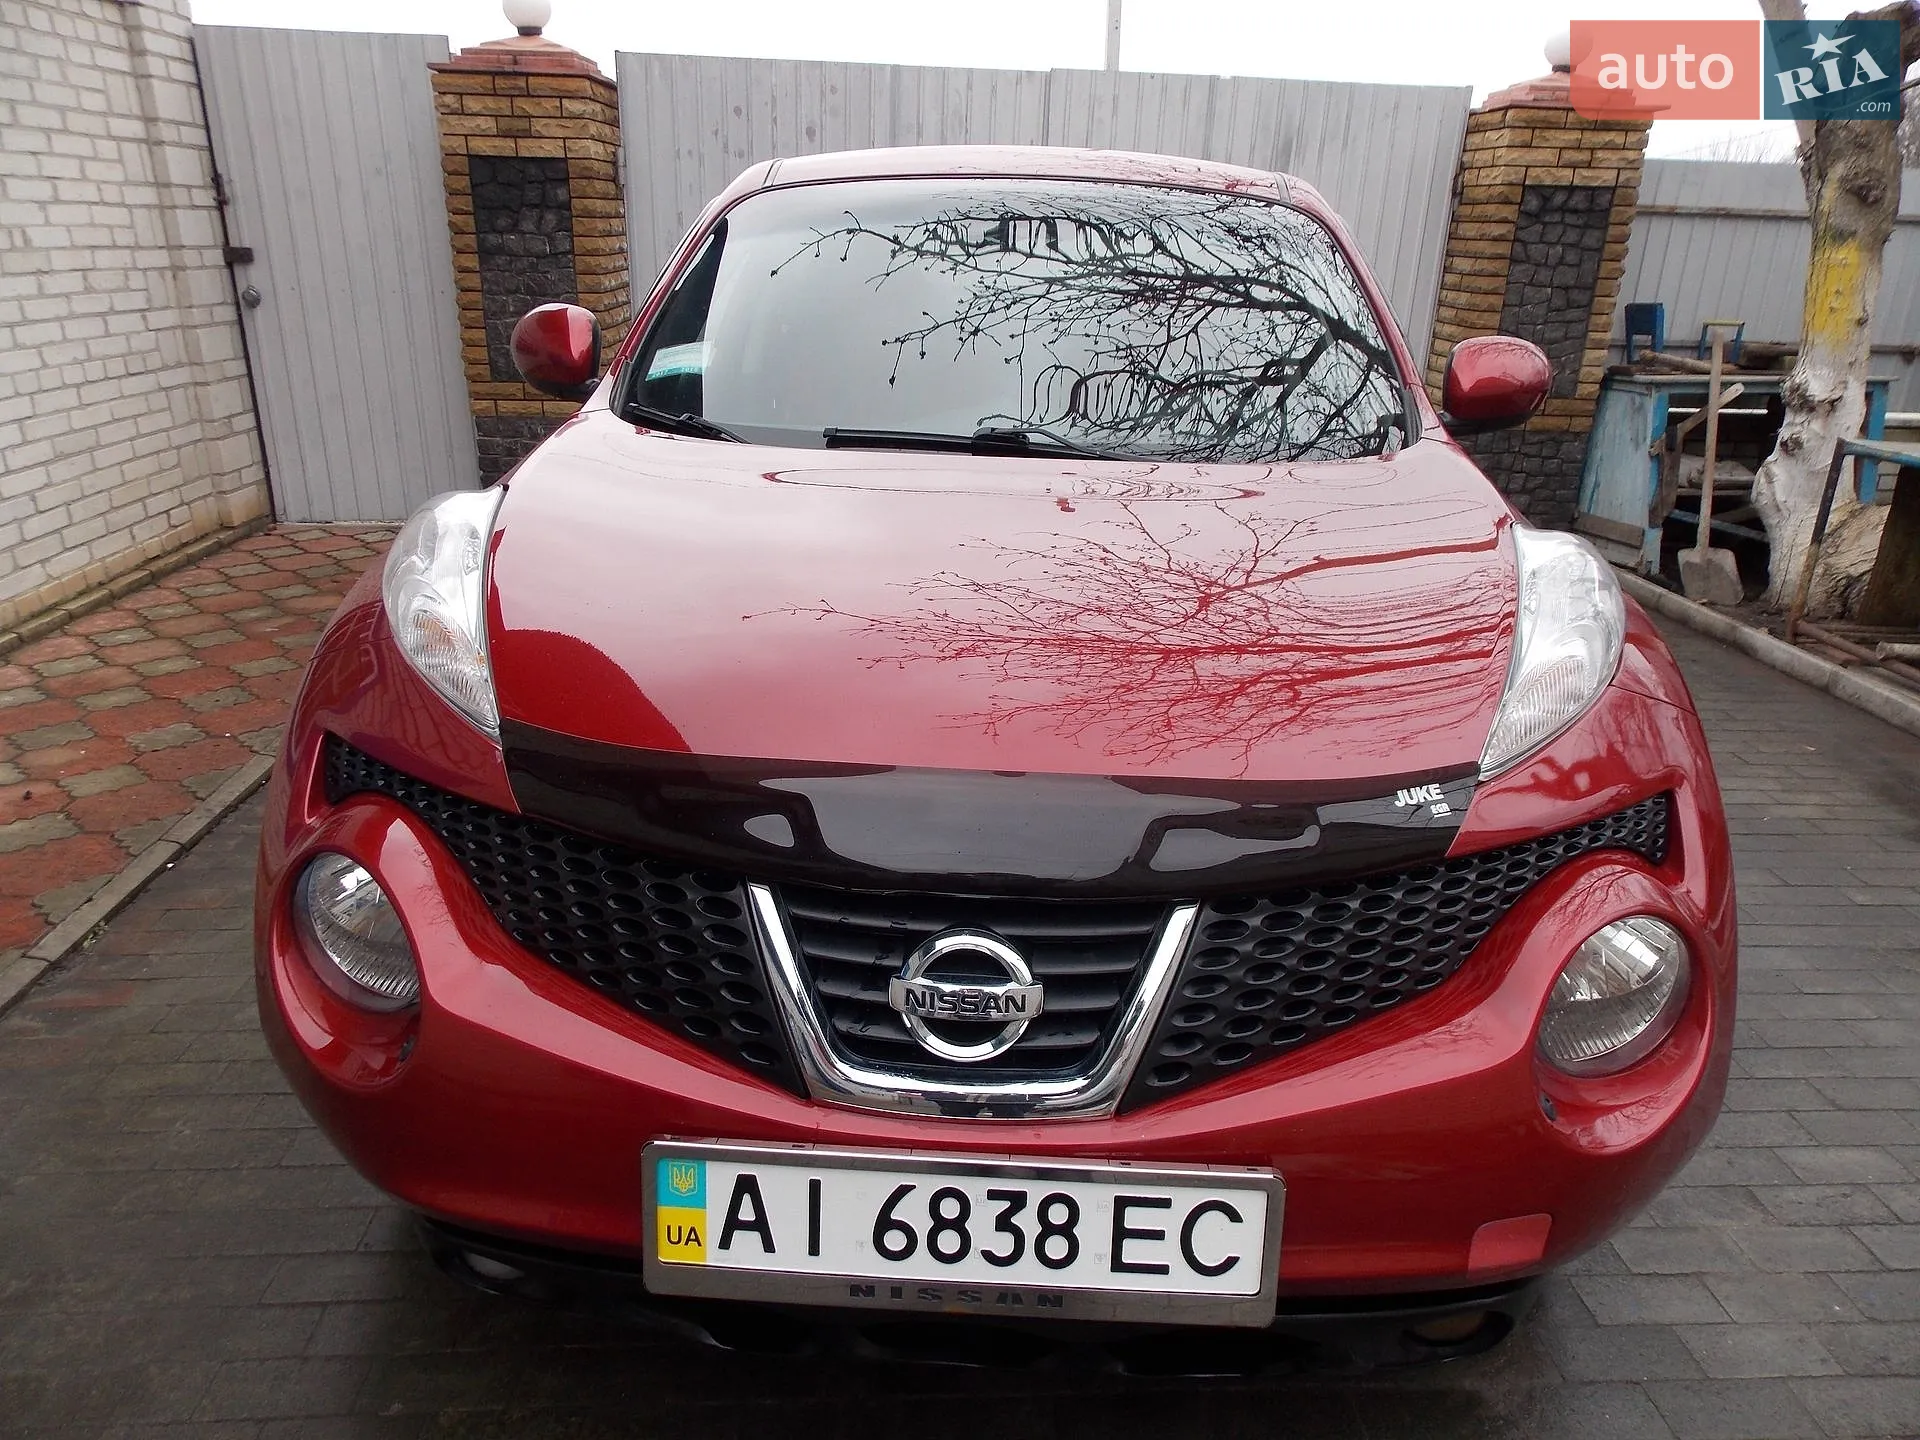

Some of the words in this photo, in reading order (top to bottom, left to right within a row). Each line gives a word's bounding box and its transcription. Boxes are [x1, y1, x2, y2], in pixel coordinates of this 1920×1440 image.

[1394, 783, 1444, 807] JUKE
[905, 988, 1027, 1014] NISSAN
[666, 1224, 702, 1247] UA
[872, 1183, 1081, 1270] 6838
[1110, 1194, 1244, 1277] EC
[849, 1284, 1064, 1307] NISSAN
